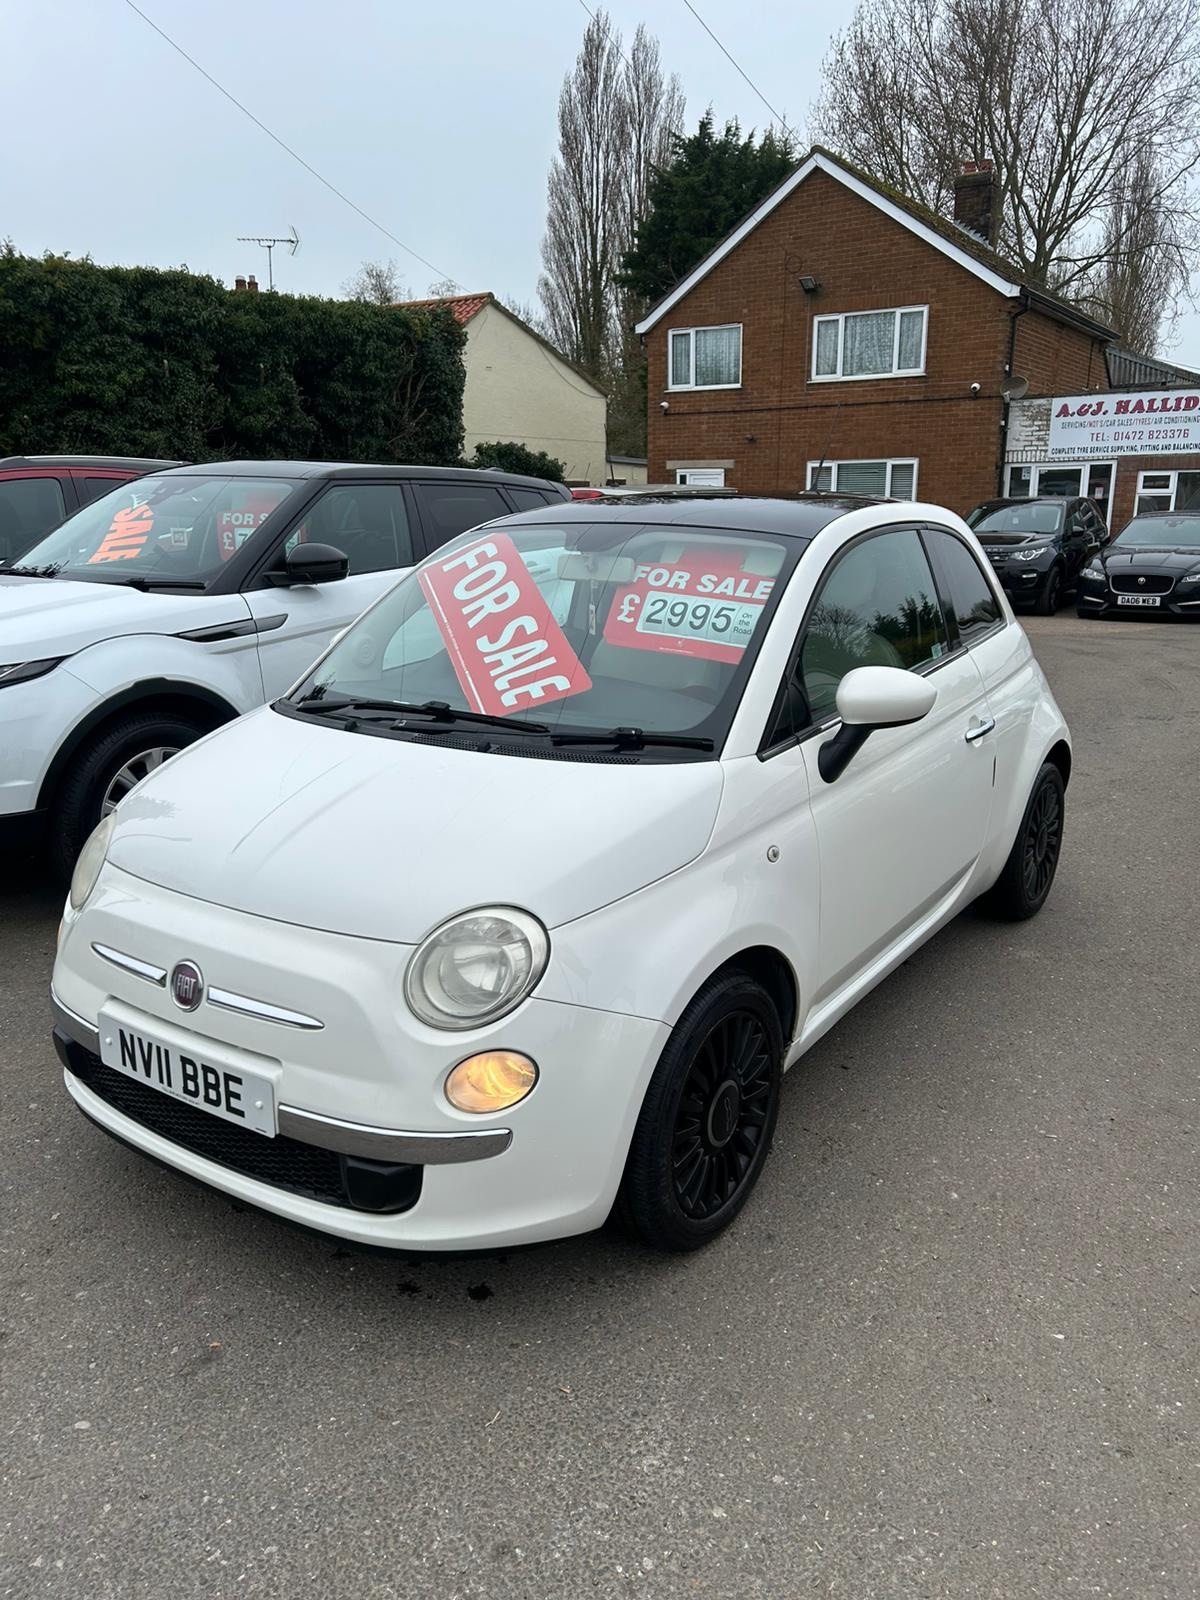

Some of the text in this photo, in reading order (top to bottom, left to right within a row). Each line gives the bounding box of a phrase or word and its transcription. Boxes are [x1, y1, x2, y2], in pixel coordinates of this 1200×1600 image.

[1114, 396, 1200, 415] HALLID
[1091, 428, 1190, 442] TEL: 01472 823376
[1051, 446, 1076, 455] COMPLETE
[1077, 446, 1089, 454] TYRE
[1090, 445, 1109, 454] SERVICE
[1140, 444, 1160, 452] FITTING
[1161, 443, 1171, 451] AND
[222, 512, 254, 525] FOR
[88, 504, 154, 564] SALE
[633, 565, 776, 600] FOR SALE
[442, 542, 571, 707] FOR SALE
[733, 626, 752, 635] Road
[739, 619, 751, 627] the
[176, 972, 197, 1000] FIAT
[179, 1054, 246, 1119] BBE
